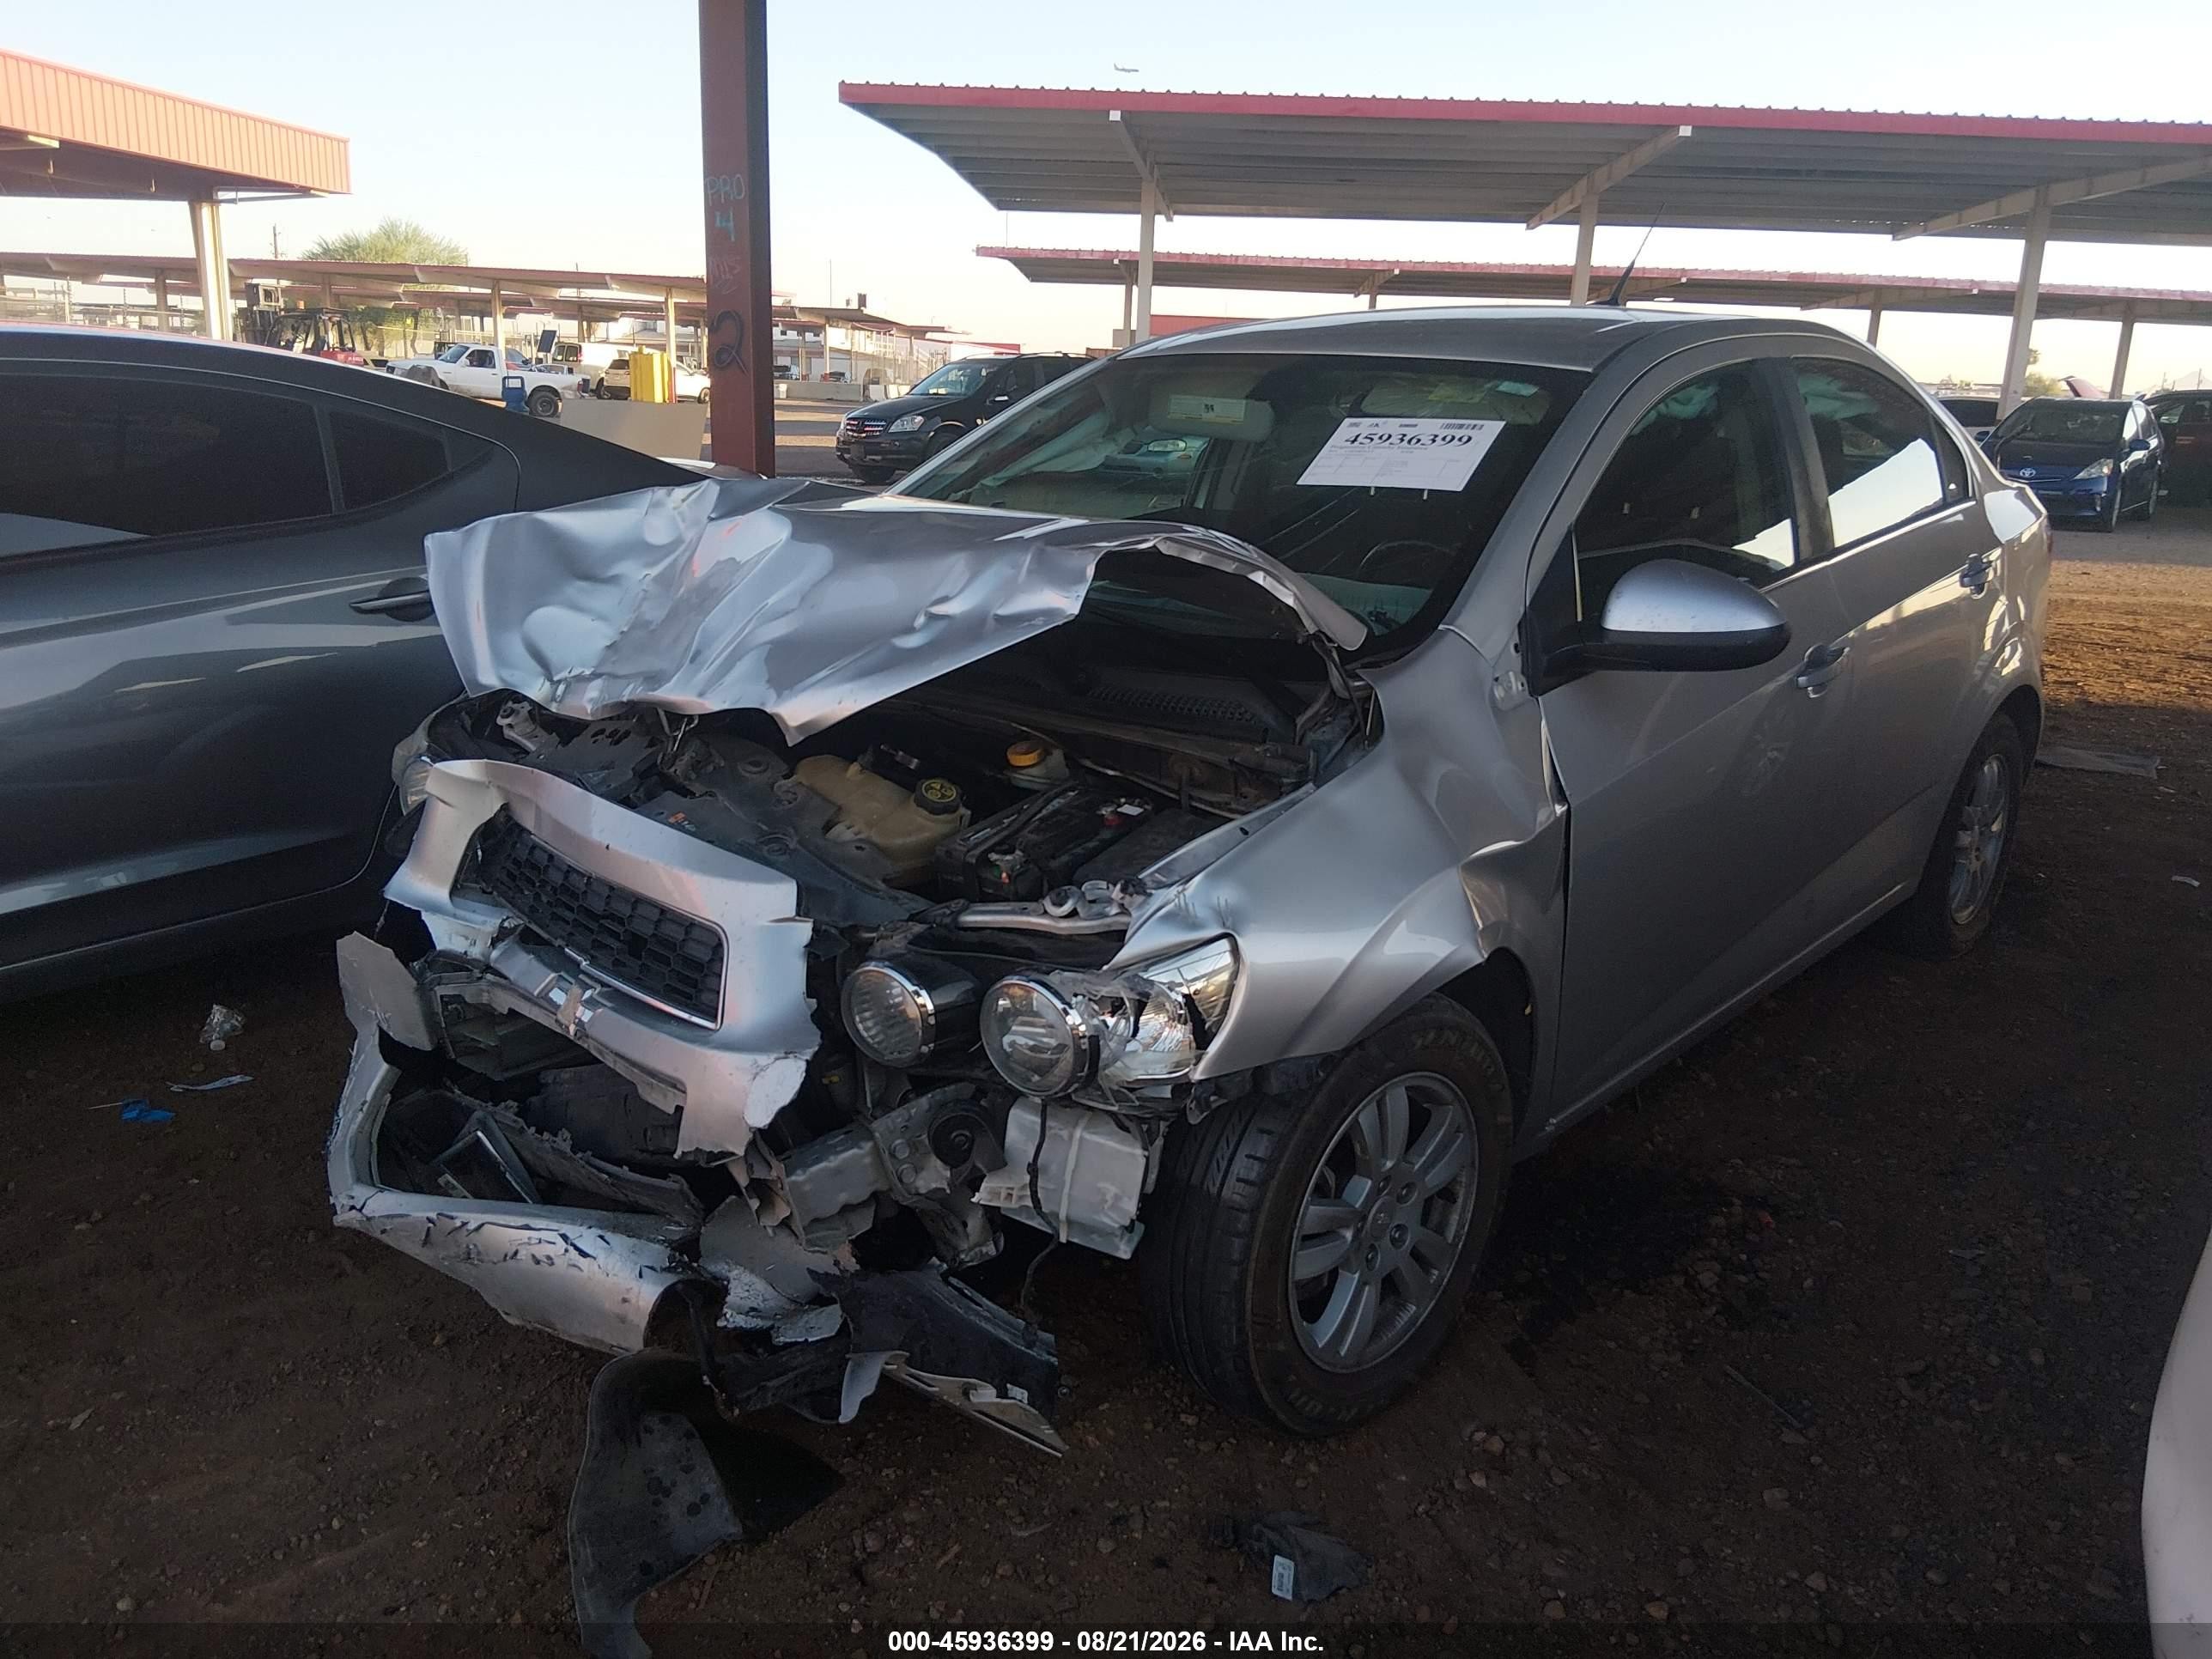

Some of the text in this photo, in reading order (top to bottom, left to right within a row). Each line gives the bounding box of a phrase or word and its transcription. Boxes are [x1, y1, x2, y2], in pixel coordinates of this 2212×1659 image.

[714, 206, 735, 241] 4
[710, 308, 749, 377] 2
[1345, 432, 1474, 447] 45936399
